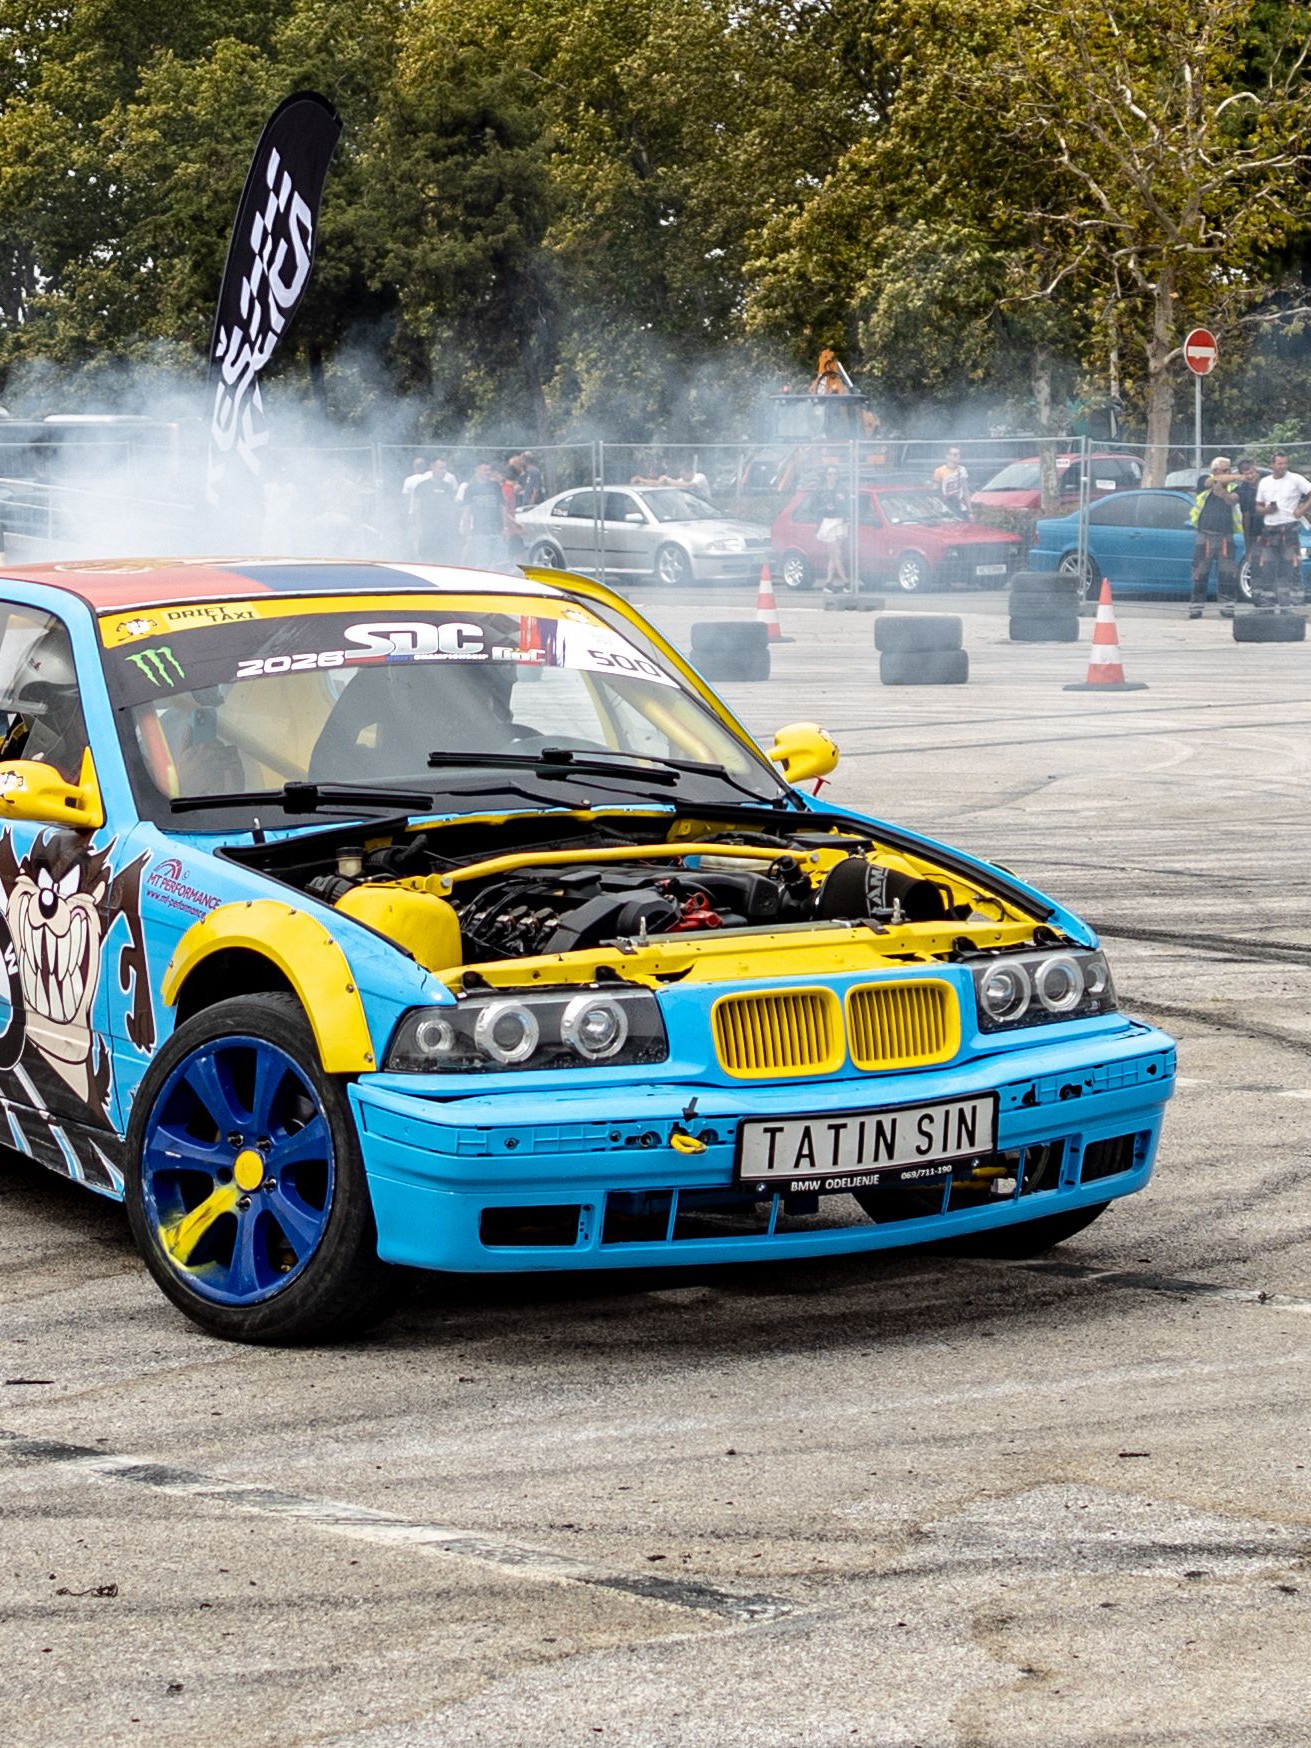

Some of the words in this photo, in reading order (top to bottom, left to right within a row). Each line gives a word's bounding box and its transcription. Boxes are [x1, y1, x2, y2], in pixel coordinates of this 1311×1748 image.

[168, 606, 226, 620] DRIFT
[211, 611, 255, 622] TAXI
[343, 621, 485, 659] SDC
[160, 877, 222, 909] PERFORMANCE
[763, 1117, 897, 1170] TATIN
[915, 1104, 977, 1156] SIN
[790, 1180, 821, 1192] BMW
[825, 1174, 880, 1190] ODELJENJE
